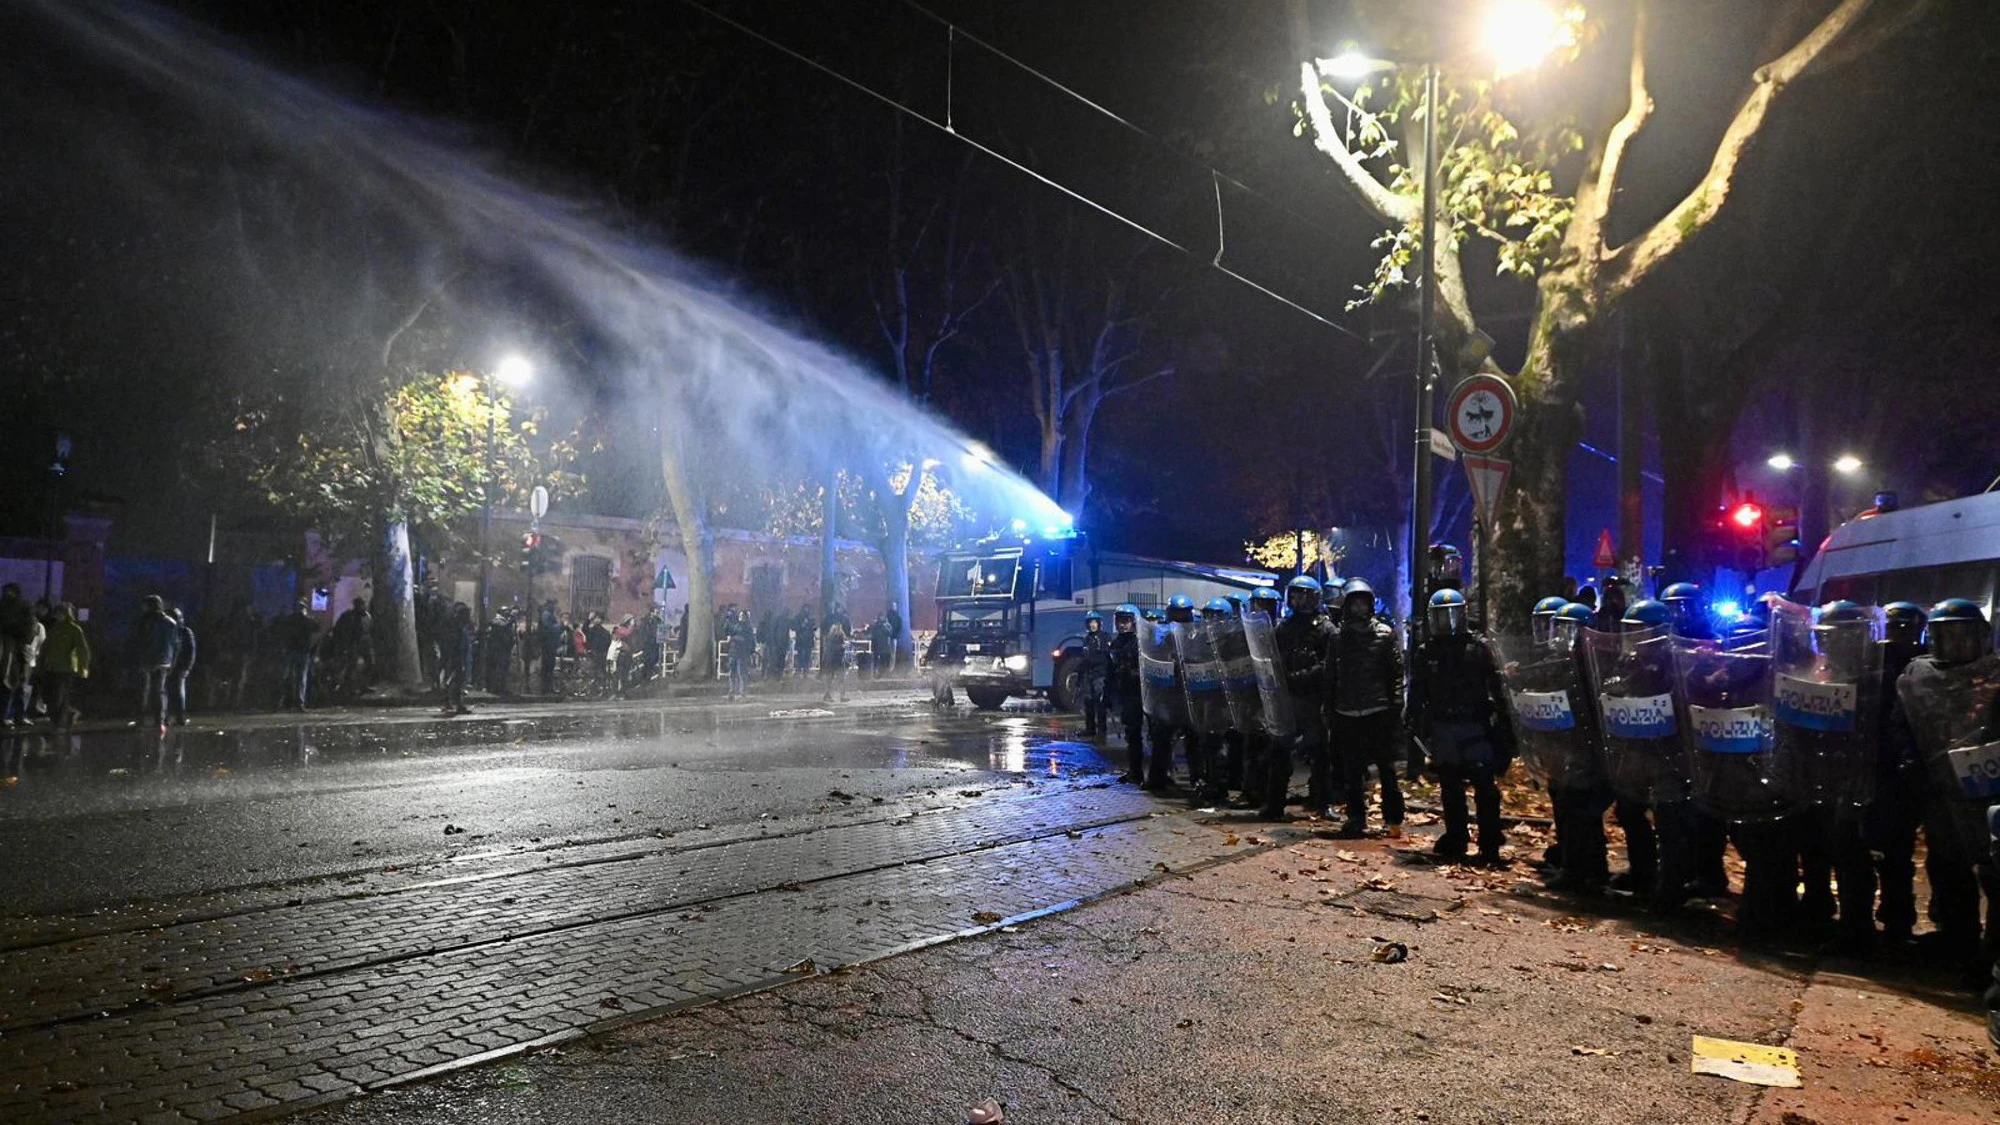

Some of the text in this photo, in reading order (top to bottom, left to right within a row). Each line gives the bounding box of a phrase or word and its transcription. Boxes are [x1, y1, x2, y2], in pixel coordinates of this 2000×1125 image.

[1780, 688, 1845, 718] POLIZIA
[1606, 706, 1667, 725] POLIZIA
[1700, 719, 1761, 738] POLIZIA
[1967, 757, 2000, 784] PO
